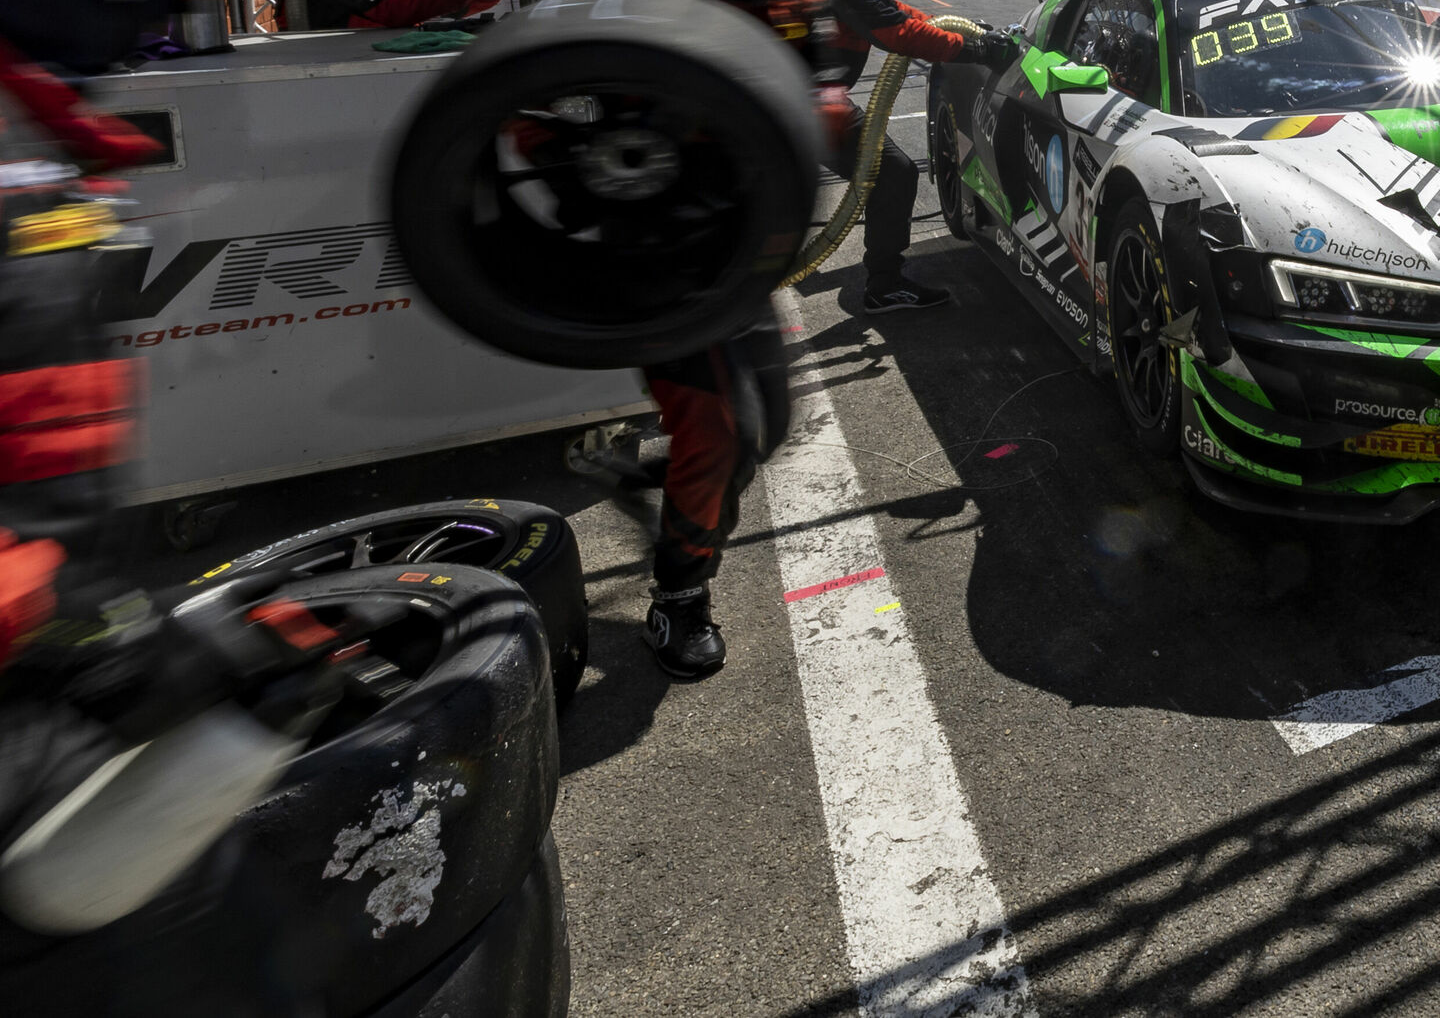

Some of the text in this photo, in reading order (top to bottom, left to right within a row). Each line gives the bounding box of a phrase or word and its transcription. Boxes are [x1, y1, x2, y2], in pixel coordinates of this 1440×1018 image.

[1191, 12, 1294, 66] 039
[1326, 238, 1431, 272] hutchison
[496, 522, 550, 576] PIREL
